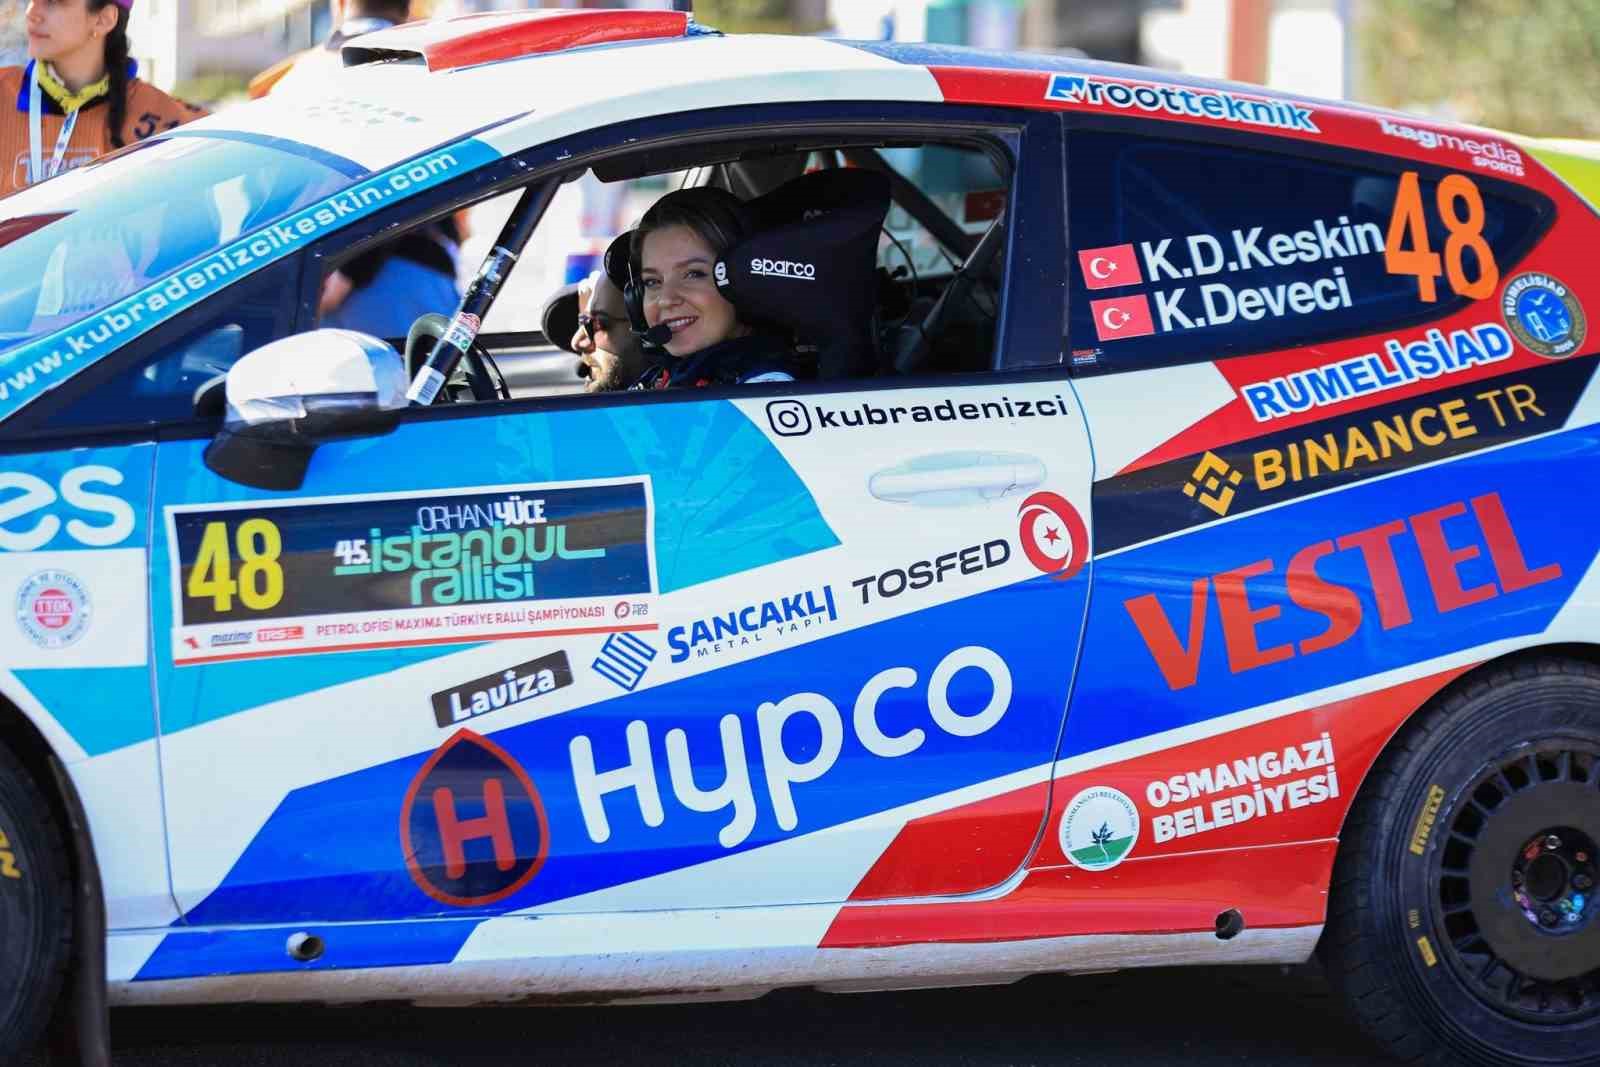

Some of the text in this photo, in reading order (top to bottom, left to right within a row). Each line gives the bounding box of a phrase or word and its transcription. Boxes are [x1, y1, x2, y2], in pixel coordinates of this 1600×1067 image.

[1089, 80, 1317, 132] rootteknik
[1473, 156, 1525, 176] SPORTS
[751, 257, 816, 278] sparco
[1141, 216, 1386, 283] K.D.Keskin
[1384, 171, 1498, 302] 48
[0, 155, 458, 402] ww.kubradenizcikeskin.com
[1153, 272, 1352, 332] K.Deveci
[1246, 327, 1511, 420] RUMELİSİAD
[816, 395, 1068, 428] kubradenizci
[1252, 384, 1546, 491] BINANCE TR
[334, 521, 606, 574] 45. istanbul
[417, 496, 548, 532] ORHAN YÜCE
[187, 519, 285, 612] 48
[851, 538, 1011, 605] TOSFED
[1123, 492, 1562, 691] VESTEL
[667, 585, 838, 664] SANCAKLI
[697, 616, 824, 658] METAL YAPI
[450, 668, 557, 723] Laviza
[569, 645, 1013, 849] Hypco
[1145, 732, 1335, 809] OSMANGAZİ
[1152, 770, 1340, 844] BELEDİYESİ
